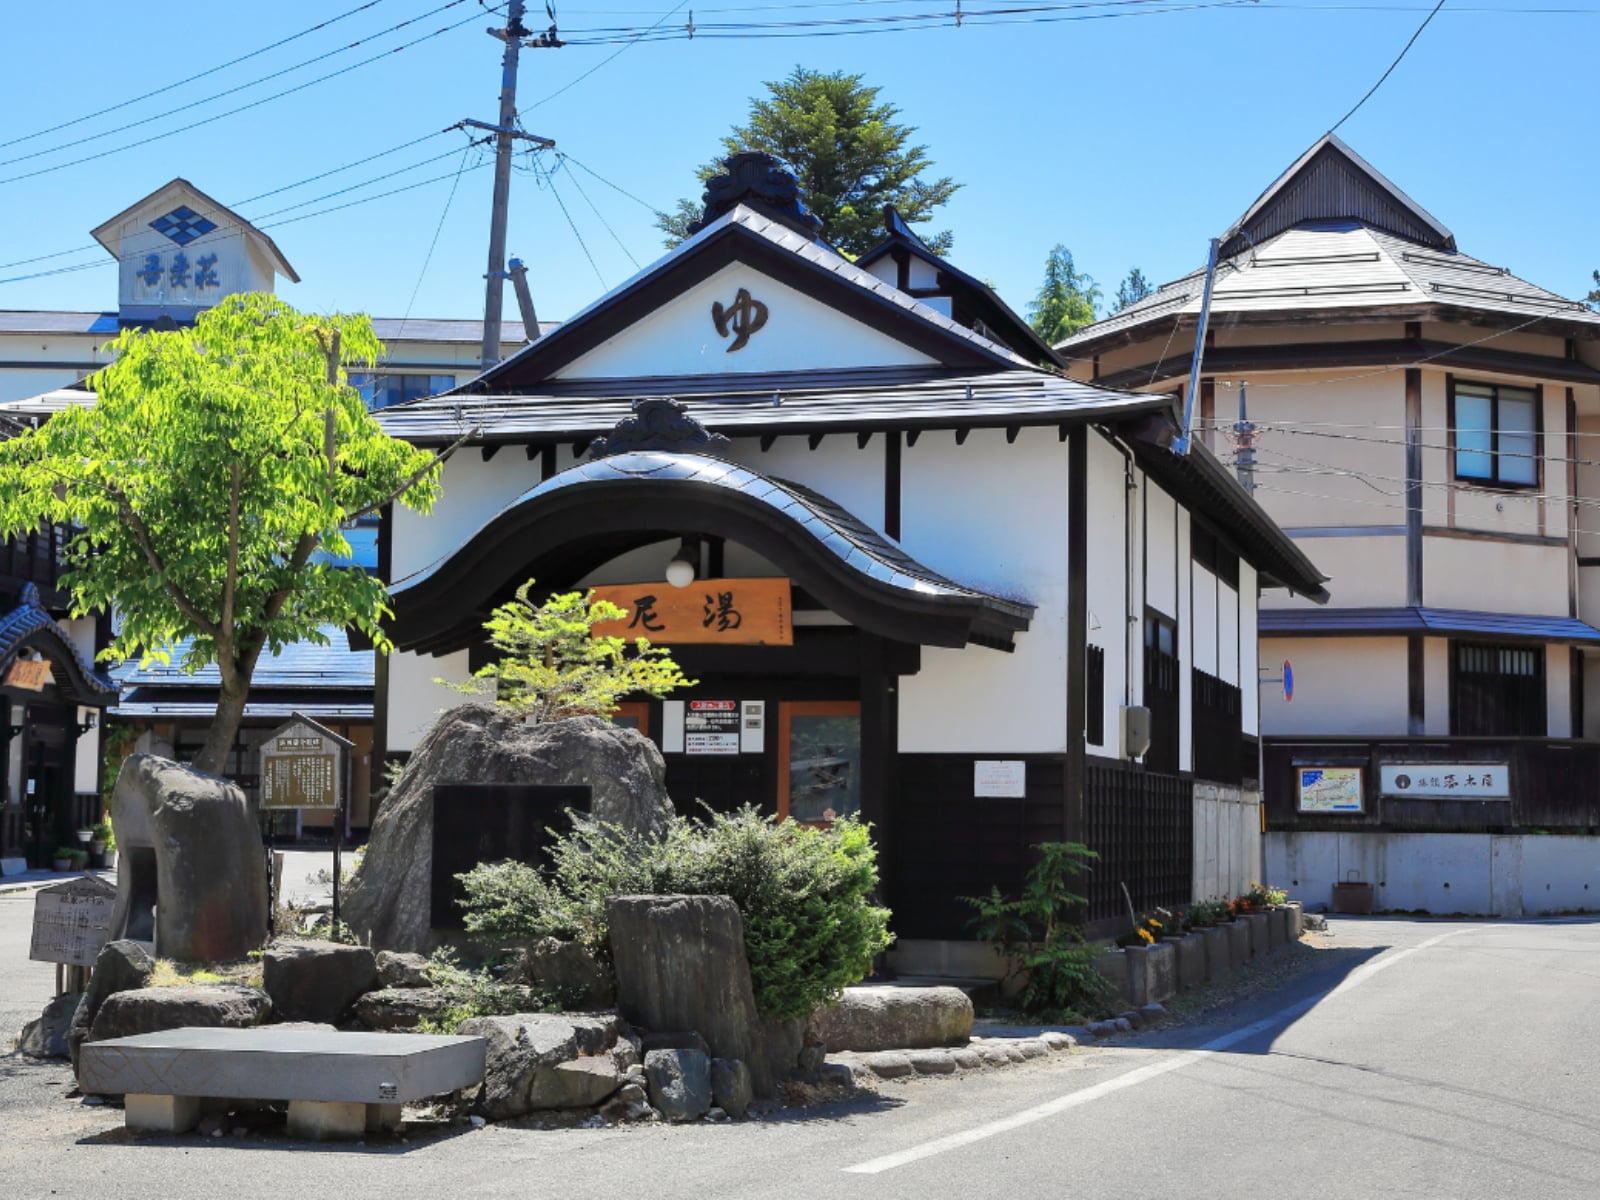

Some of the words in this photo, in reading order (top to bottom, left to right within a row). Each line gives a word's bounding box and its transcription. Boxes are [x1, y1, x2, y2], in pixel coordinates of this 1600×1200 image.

[136, 252, 220, 290] 吾妻荘
[711, 287, 769, 353] ゆ
[628, 591, 742, 632] 尼湯
